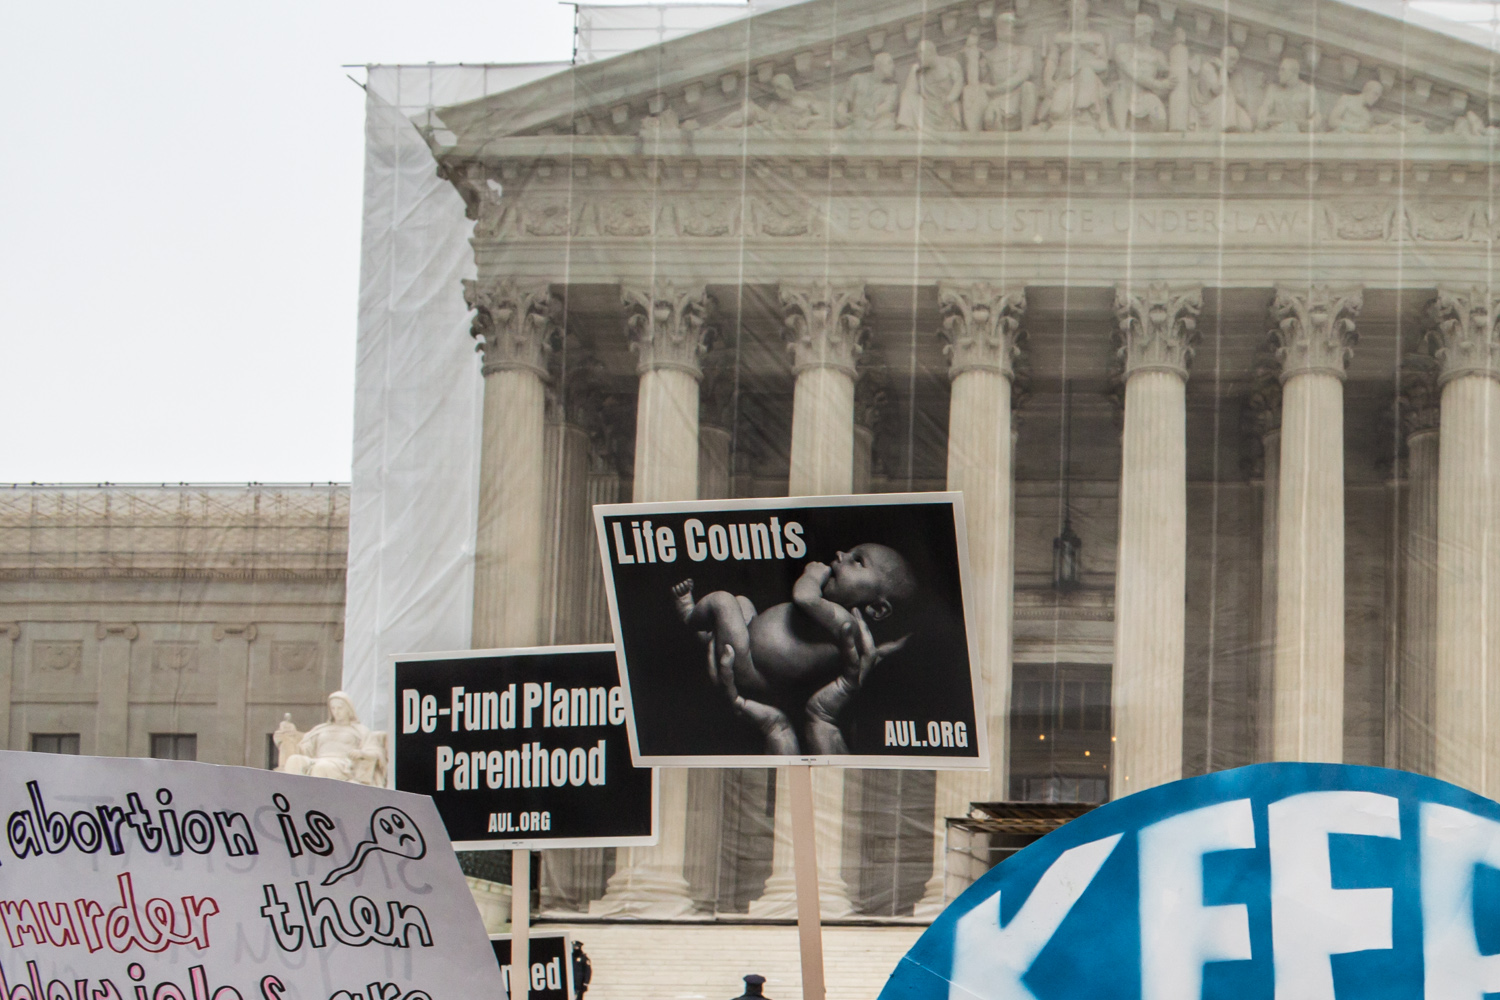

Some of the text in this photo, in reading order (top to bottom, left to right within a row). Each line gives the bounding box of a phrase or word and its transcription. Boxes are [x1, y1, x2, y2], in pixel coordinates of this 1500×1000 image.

[612, 517, 807, 564] Life Counts
[402, 682, 627, 734] De-Fund Planne
[884, 720, 968, 748] AUL.ORG
[436, 739, 606, 791] Parenthood
[7, 780, 336, 860] abortion is
[488, 811, 551, 833] AUL.ORG
[0, 872, 434, 954] murder then
